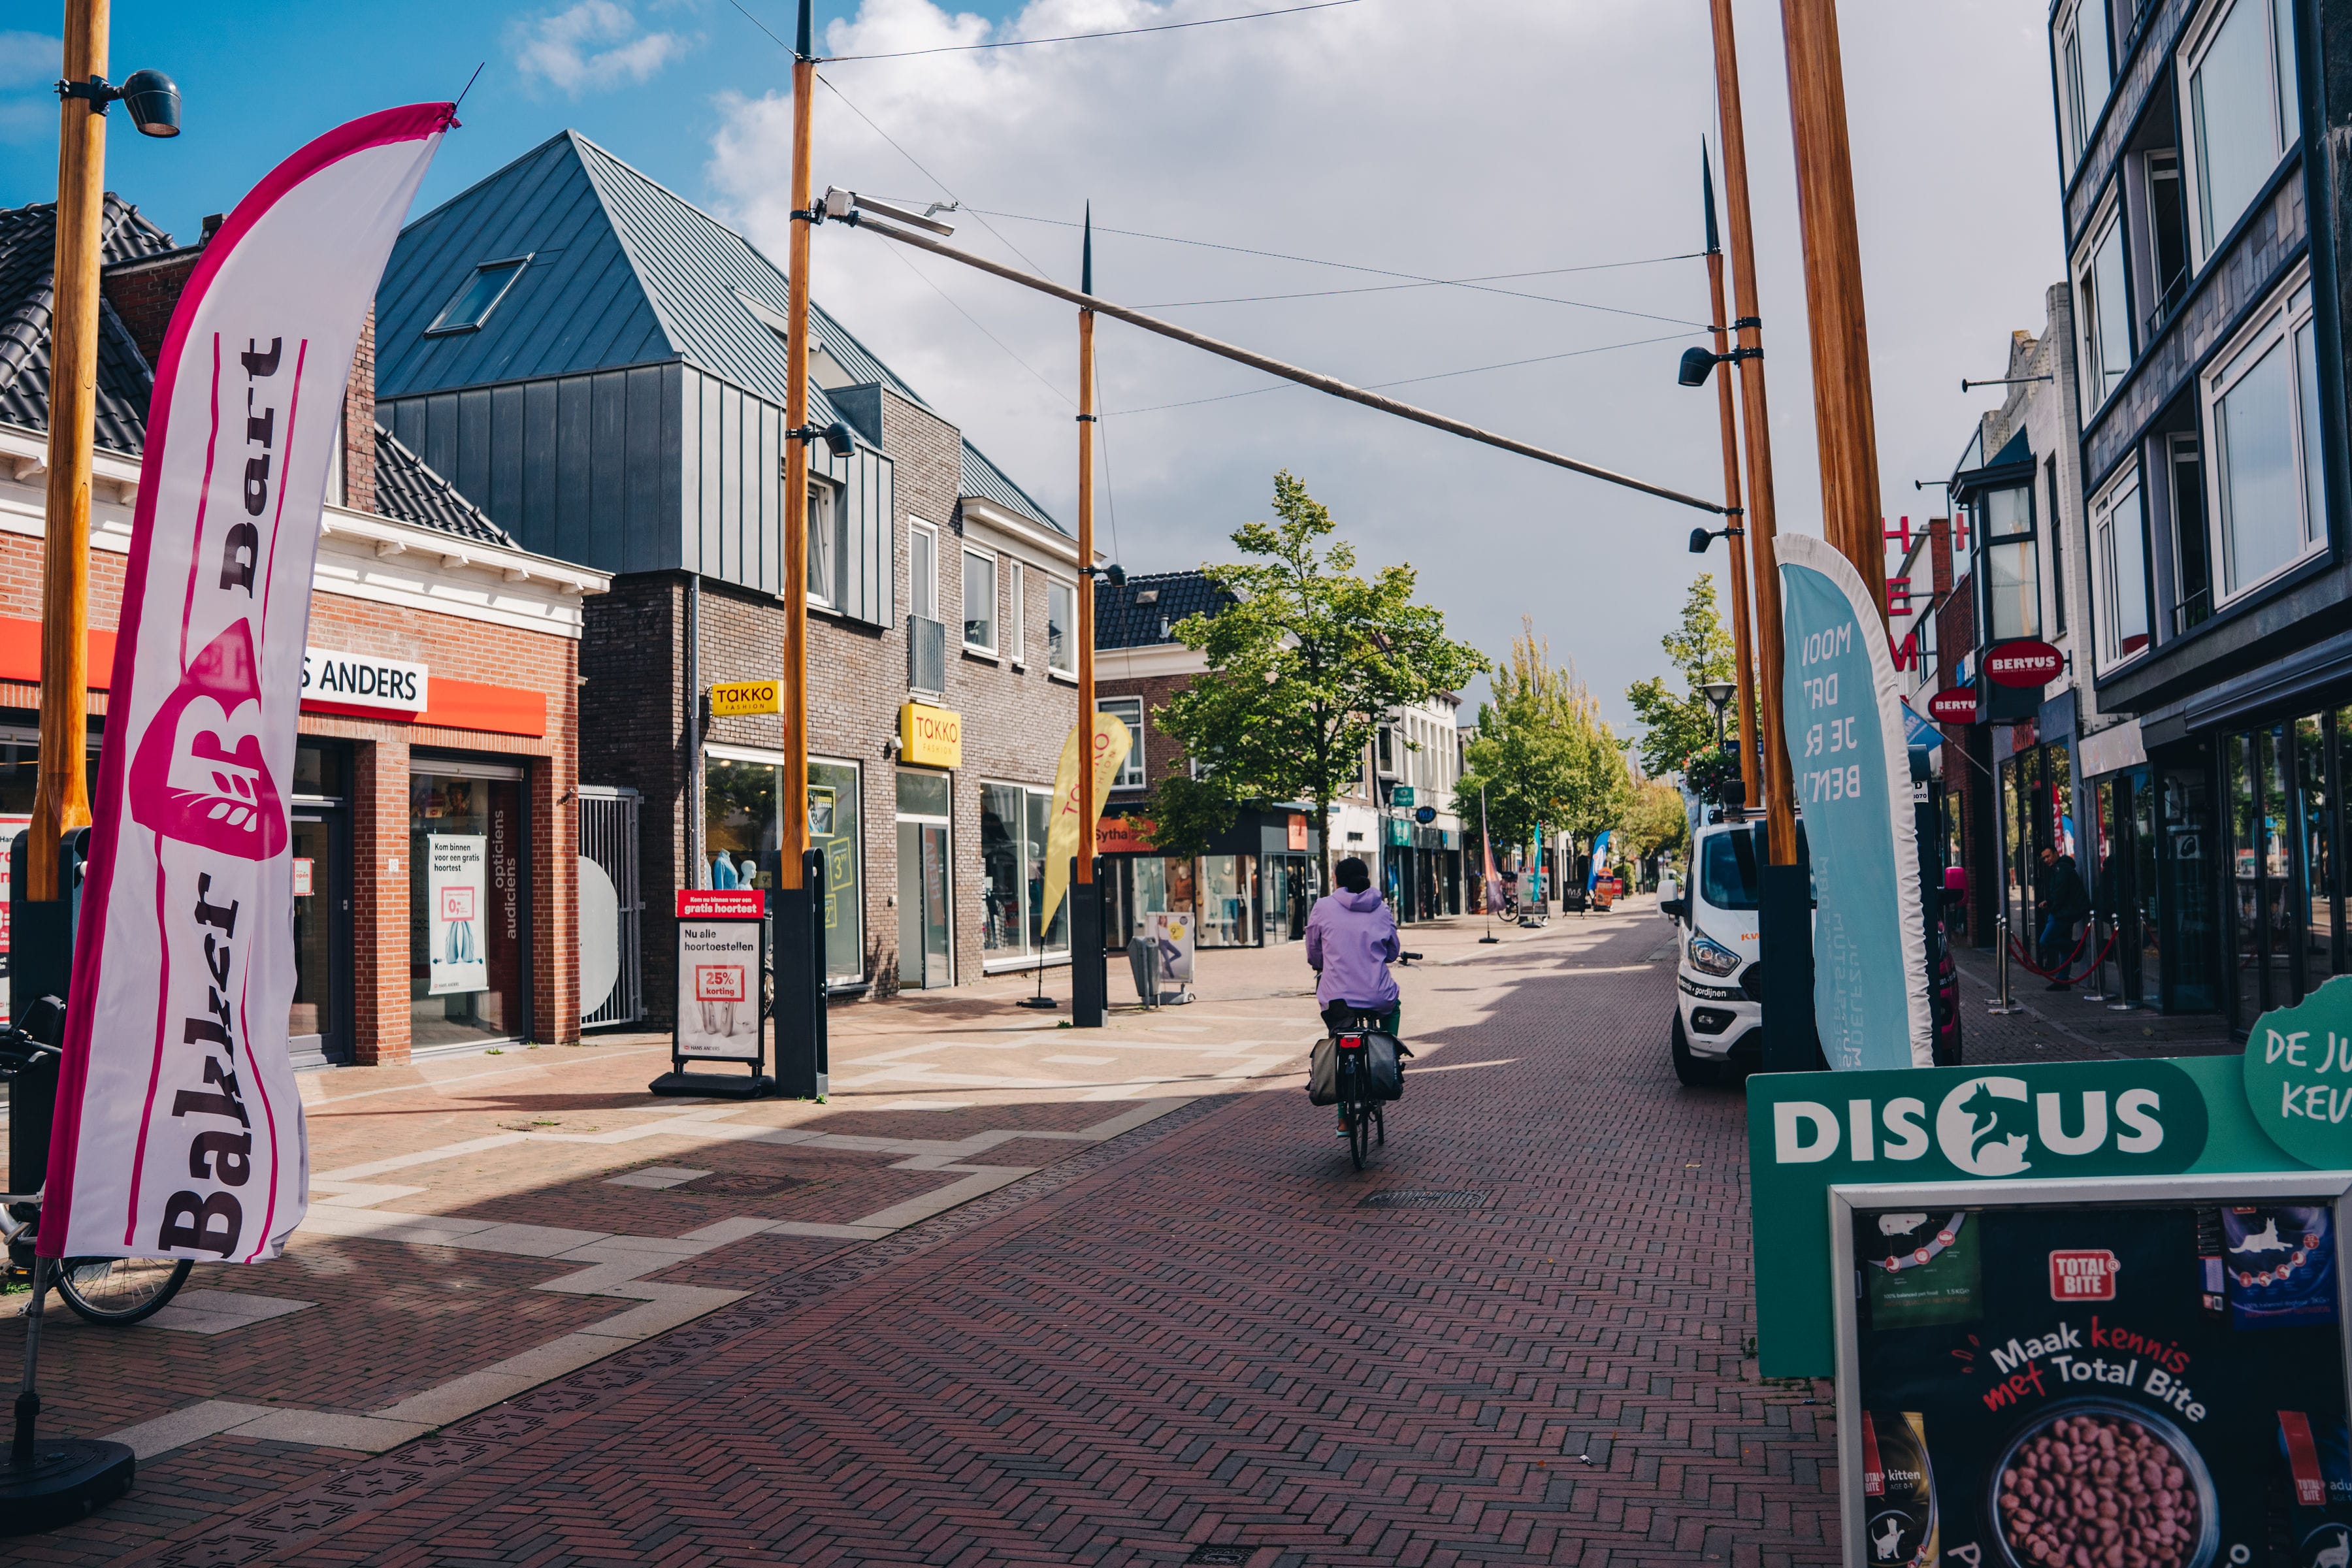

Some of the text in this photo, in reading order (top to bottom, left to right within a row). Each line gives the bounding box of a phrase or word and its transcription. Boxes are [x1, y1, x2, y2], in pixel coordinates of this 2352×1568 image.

[219, 336, 282, 599] Bart
[1992, 655, 2056, 670] BERTUS
[319, 659, 417, 701] ANDERS
[923, 743, 952, 755] FASHION
[434, 843, 471, 851] Kom binnen
[493, 809, 506, 889] opticiens
[462, 853, 480, 863] gratis
[504, 857, 516, 939] audiciens
[684, 903, 757, 915] gratis hoortest
[685, 929, 716, 938] Nu alle
[684, 941, 754, 951] hoortoestellen
[706, 972, 734, 985] 25%
[706, 987, 735, 997] korting
[1695, 987, 1727, 998] gordijnen
[2265, 1028, 2310, 1067] DE
[1772, 1075, 2164, 1177] DISCUS
[2055, 1258, 2108, 1276] TOTAL
[2063, 1275, 2102, 1294] BITE
[1990, 1315, 2191, 1374] Maak kennis
[1982, 1355, 2206, 1422] met Total Bite
[1887, 1469, 1921, 1481] kitten
[2297, 1479, 2321, 1490] TOTAL
[2302, 1490, 2320, 1501] BITE
